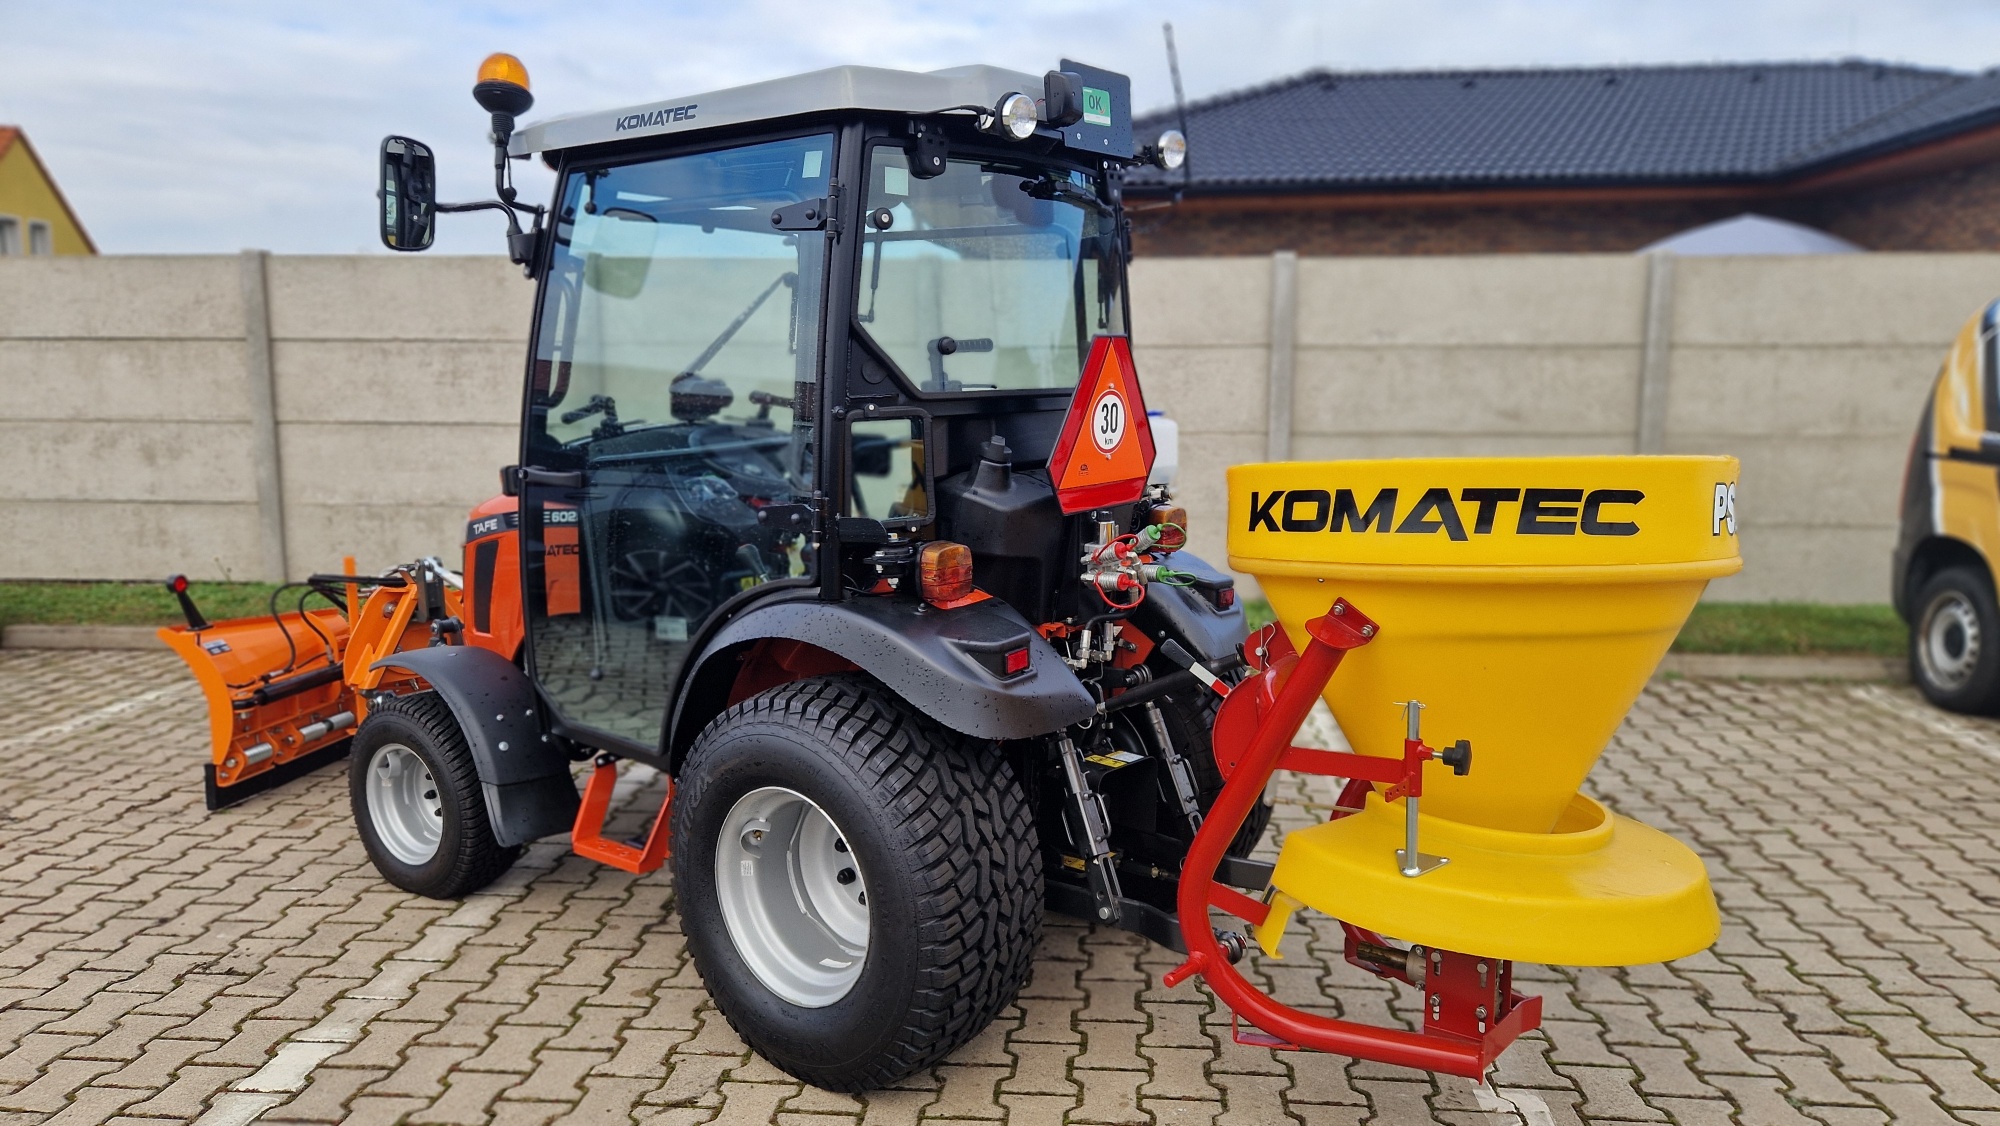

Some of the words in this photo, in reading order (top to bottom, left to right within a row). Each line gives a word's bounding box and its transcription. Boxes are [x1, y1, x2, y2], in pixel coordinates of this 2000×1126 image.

[1088, 95, 1102, 111] OK
[615, 104, 698, 132] KOMATEC
[1101, 403, 1118, 434] 30
[1104, 437, 1113, 445] km
[551, 510, 579, 523] 602
[1248, 487, 1646, 542] KOMATEC
[1712, 481, 1737, 537] PS
[473, 518, 498, 535] TAFE
[544, 544, 579, 557] ATEC
